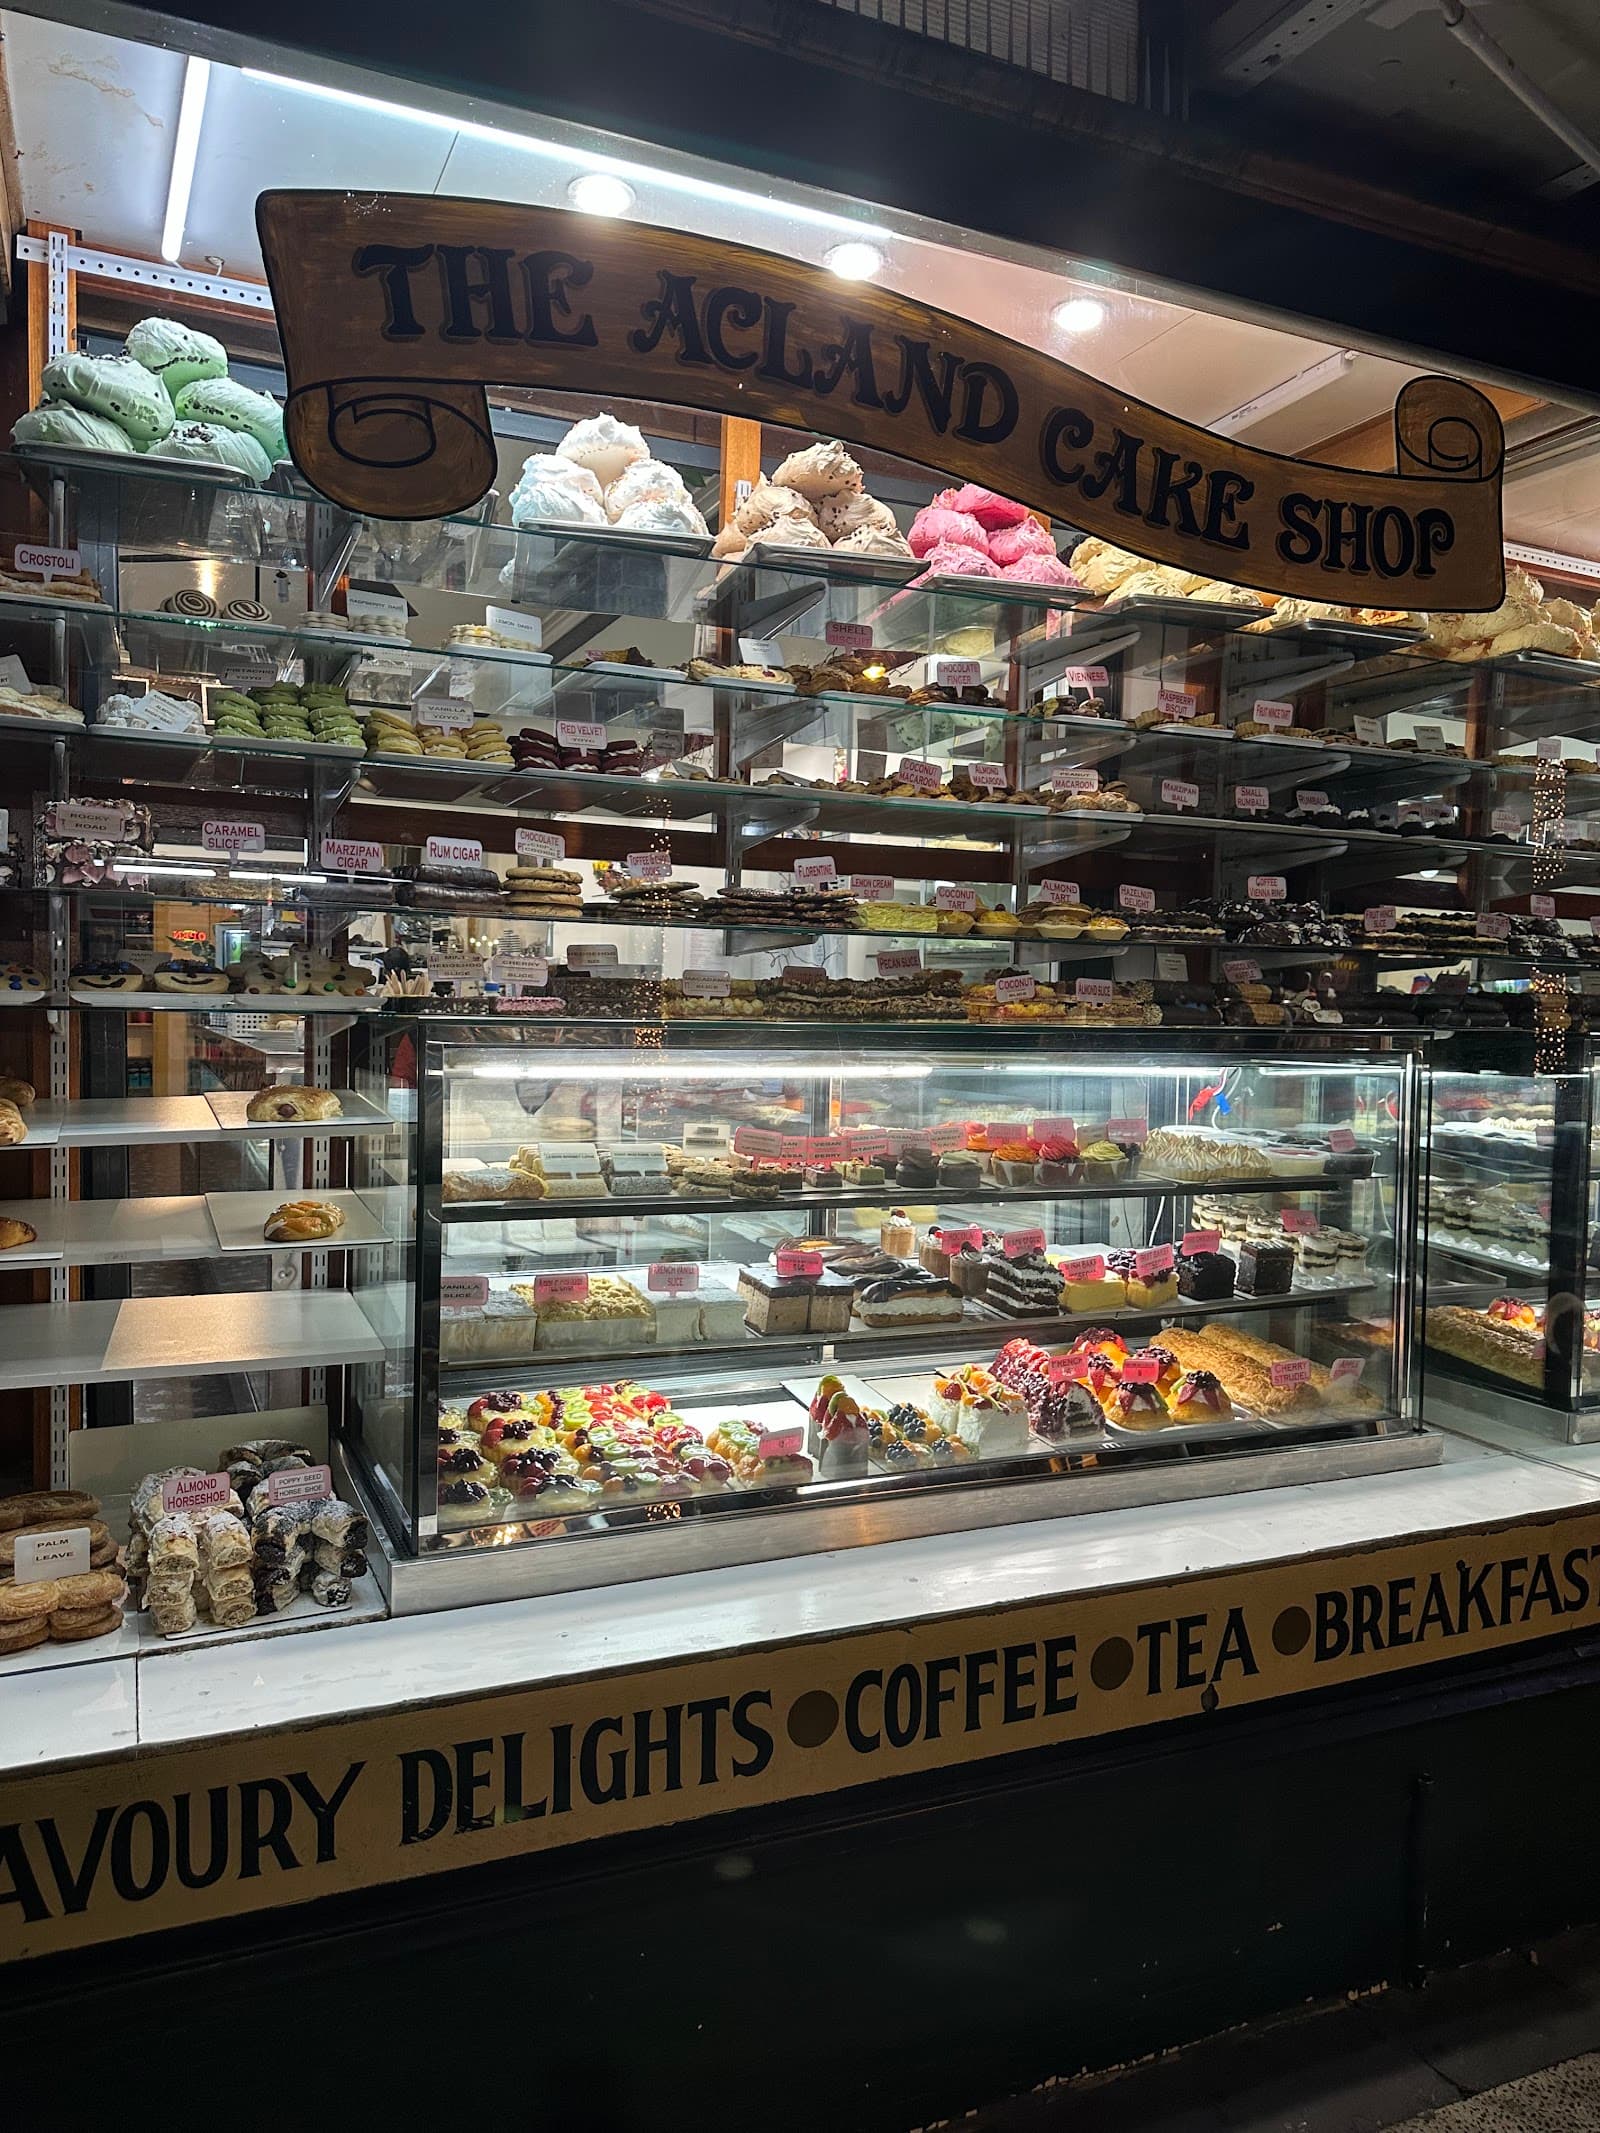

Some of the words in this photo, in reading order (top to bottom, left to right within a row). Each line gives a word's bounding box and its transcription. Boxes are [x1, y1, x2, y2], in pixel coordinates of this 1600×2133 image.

[352, 242, 599, 347] THE
[628, 268, 1019, 444] ACLAND
[1041, 406, 1255, 552] CAKE
[1274, 492, 1456, 578] SHOP
[18, 549, 75, 570] CROSTOLI
[495, 618, 516, 627] LEMON
[832, 623, 868, 635] SHELL
[939, 662, 979, 674] CHOCOLATE
[946, 674, 972, 685] FINGER
[1068, 669, 1106, 682] VIENNESE
[1159, 689, 1195, 705] RASPBERRY
[428, 705, 466, 713] VANILLA
[1165, 703, 1187, 714] BISCUIT
[560, 722, 576, 734] RED
[577, 724, 603, 737] VELVET
[903, 760, 937, 777] COCONUT
[975, 764, 999, 776] ALMOND
[900, 771, 938, 788] MACAROON
[973, 775, 1004, 787] MACAROON
[1055, 779, 1095, 790] MACAROON
[1163, 783, 1197, 795] MARZIPAN
[1240, 786, 1263, 798] SMALL
[1237, 796, 1267, 808] RUMBALL
[70, 813, 110, 821] ROCKY
[75, 823, 107, 831] ROAD
[204, 822, 261, 838] CARAMEL
[207, 837, 240, 849] SLICE
[520, 829, 560, 847] CHOCOLATE
[325, 844, 380, 858] MARZIPAN
[429, 841, 451, 858] RUM
[452, 846, 480, 861] CIGAR
[336, 856, 368, 869] CIGAR
[629, 855, 650, 866] TOFFEE
[798, 863, 833, 878] FLORENTINE
[851, 877, 872, 889] LEMON
[873, 878, 892, 889] CREAM
[1042, 880, 1078, 894] ALMOND
[1255, 876, 1278, 887] COFFEE
[863, 889, 879, 899] SLICE
[938, 889, 975, 900] COCONUT
[1050, 892, 1071, 902] TART
[1121, 886, 1152, 899] HAZELNUT
[947, 899, 966, 910] TART
[1124, 897, 1149, 909] DELIGHT
[880, 956, 901, 970] PECAN
[901, 955, 919, 968] SLICE
[998, 977, 1033, 991] COCONUT
[1078, 983, 1097, 995] ALMOND
[1098, 985, 1110, 997] SLICE
[667, 1277, 683, 1287] SLICE
[1274, 1361, 1307, 1374] CHERRY
[1274, 1372, 1308, 1385] STRUDEL
[278, 1476, 301, 1486] POPPY
[304, 1473, 322, 1482] SEED
[176, 1478, 217, 1495] ALMOND
[279, 1487, 303, 1497] HORSE
[305, 1484, 323, 1494] SHOE
[167, 1490, 226, 1509] HORSESHOE
[36, 1538, 70, 1548] PALM
[34, 1550, 75, 1562] LEAVE
[1136, 1607, 1260, 1696] TEA
[844, 1635, 1079, 1754] COFFEE
[0, 1760, 367, 1924] AVOURY
[398, 1689, 775, 1847] DELIGHTS
